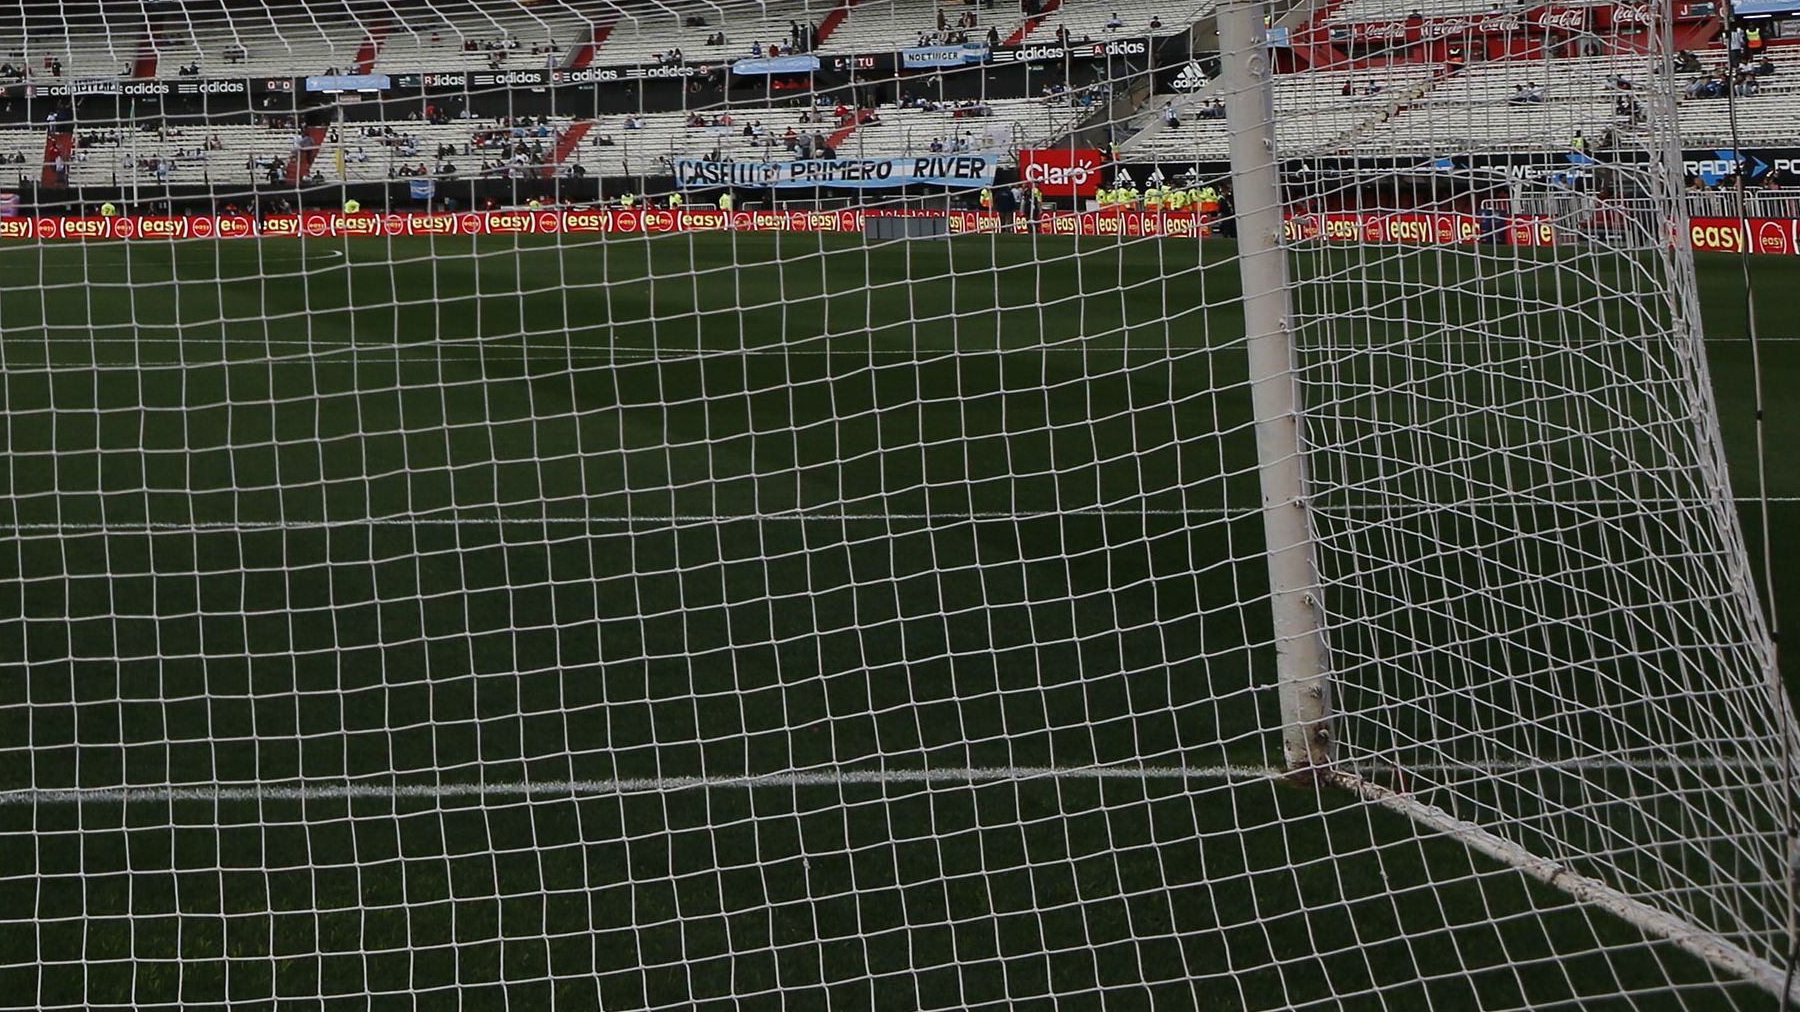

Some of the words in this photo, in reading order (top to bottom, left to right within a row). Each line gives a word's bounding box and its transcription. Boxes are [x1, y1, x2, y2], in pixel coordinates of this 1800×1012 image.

[1015, 46, 1064, 61] adidas
[1106, 41, 1145, 56] didas
[496, 72, 541, 84] adidas
[572, 69, 617, 82] adidas
[648, 65, 694, 79] adidas
[125, 82, 169, 95] adidas
[199, 80, 244, 93] adidas
[791, 160, 892, 182] PRIMERO
[913, 157, 985, 180] RIVER
[1025, 163, 1087, 186] Claro
[1762, 237, 1784, 247] easy
